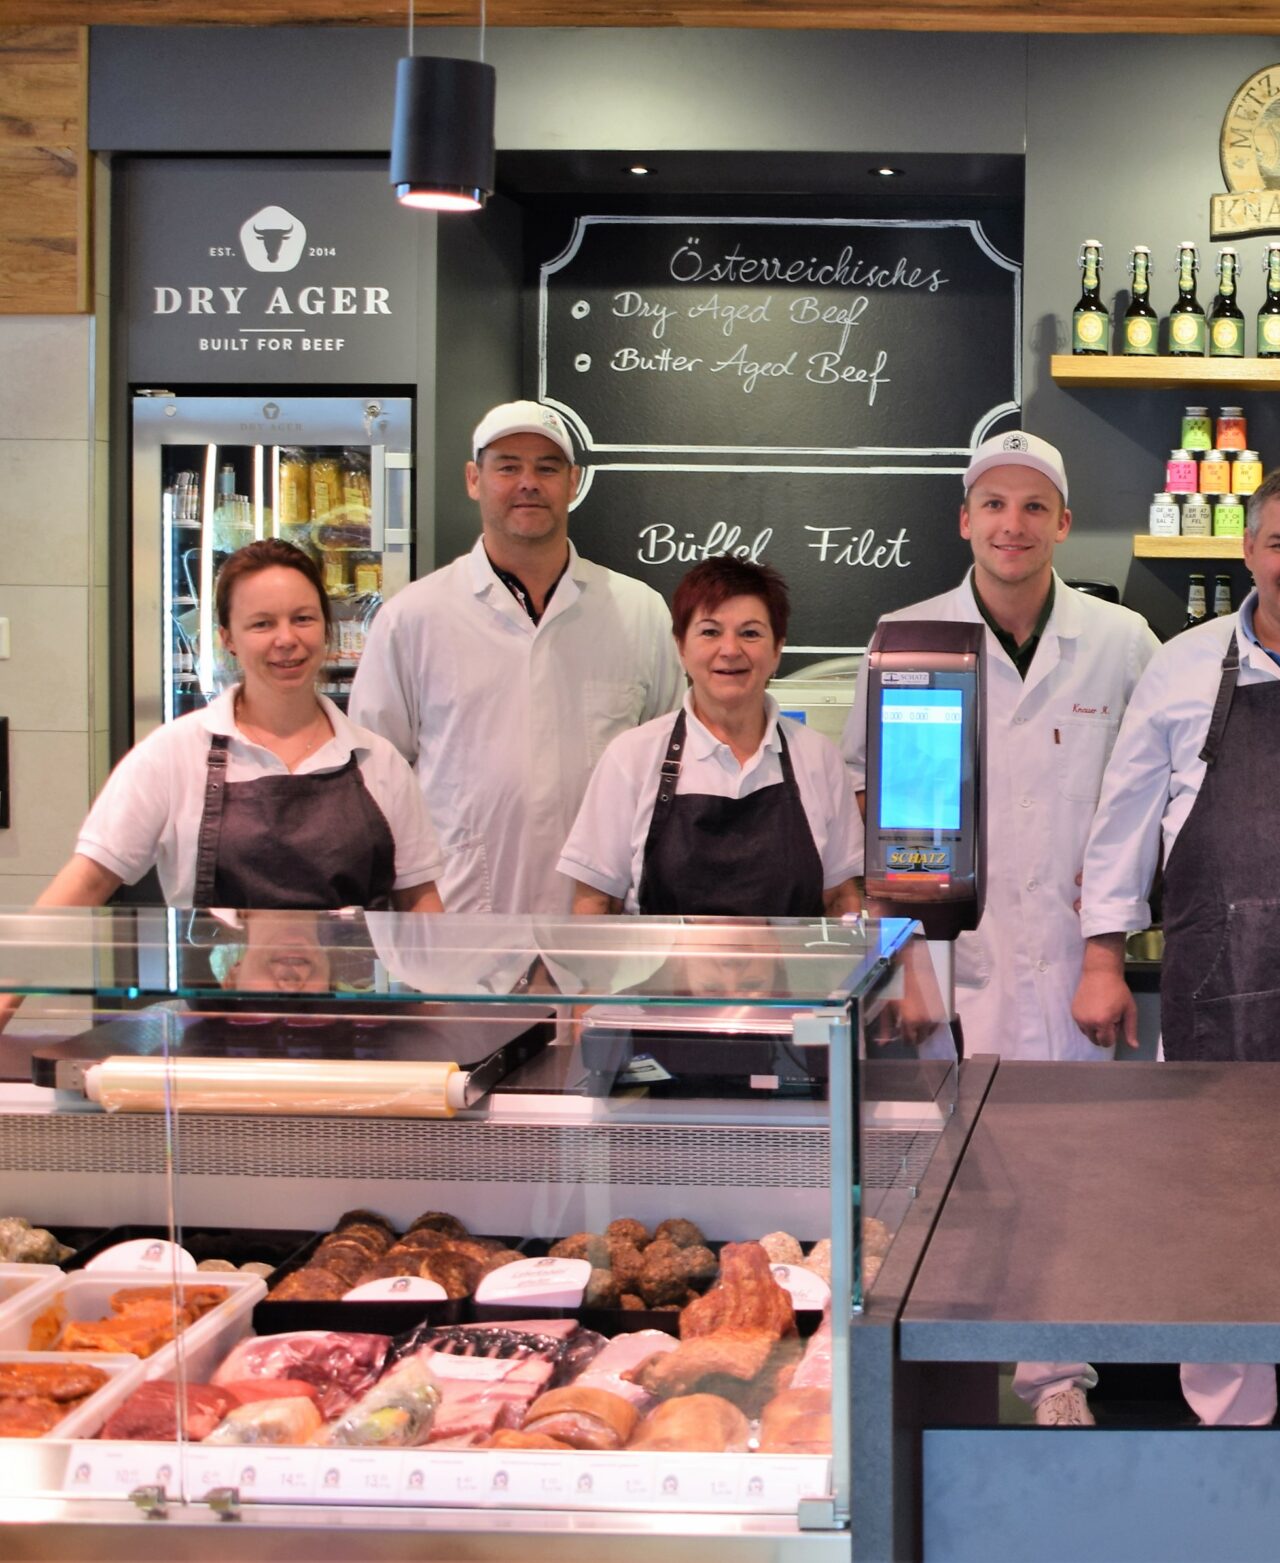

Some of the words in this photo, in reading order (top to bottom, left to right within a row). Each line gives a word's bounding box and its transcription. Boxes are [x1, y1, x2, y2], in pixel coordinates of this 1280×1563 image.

[210, 247, 236, 257] EST.
[309, 247, 337, 257] 2014
[669, 237, 950, 292] Österreichisches
[153, 286, 248, 315] DRY
[265, 286, 393, 315] AGER
[611, 291, 678, 339] Dry
[687, 293, 771, 336] Aged
[789, 295, 870, 355] Beef
[199, 338, 250, 351] BUILT
[257, 338, 294, 351] FOR
[302, 338, 346, 351] BEEF
[610, 347, 703, 373] Butter
[710, 344, 798, 393] Aged
[805, 351, 892, 406] Beef
[803, 524, 912, 570] Filet
[890, 852, 946, 864] SCHATZ
